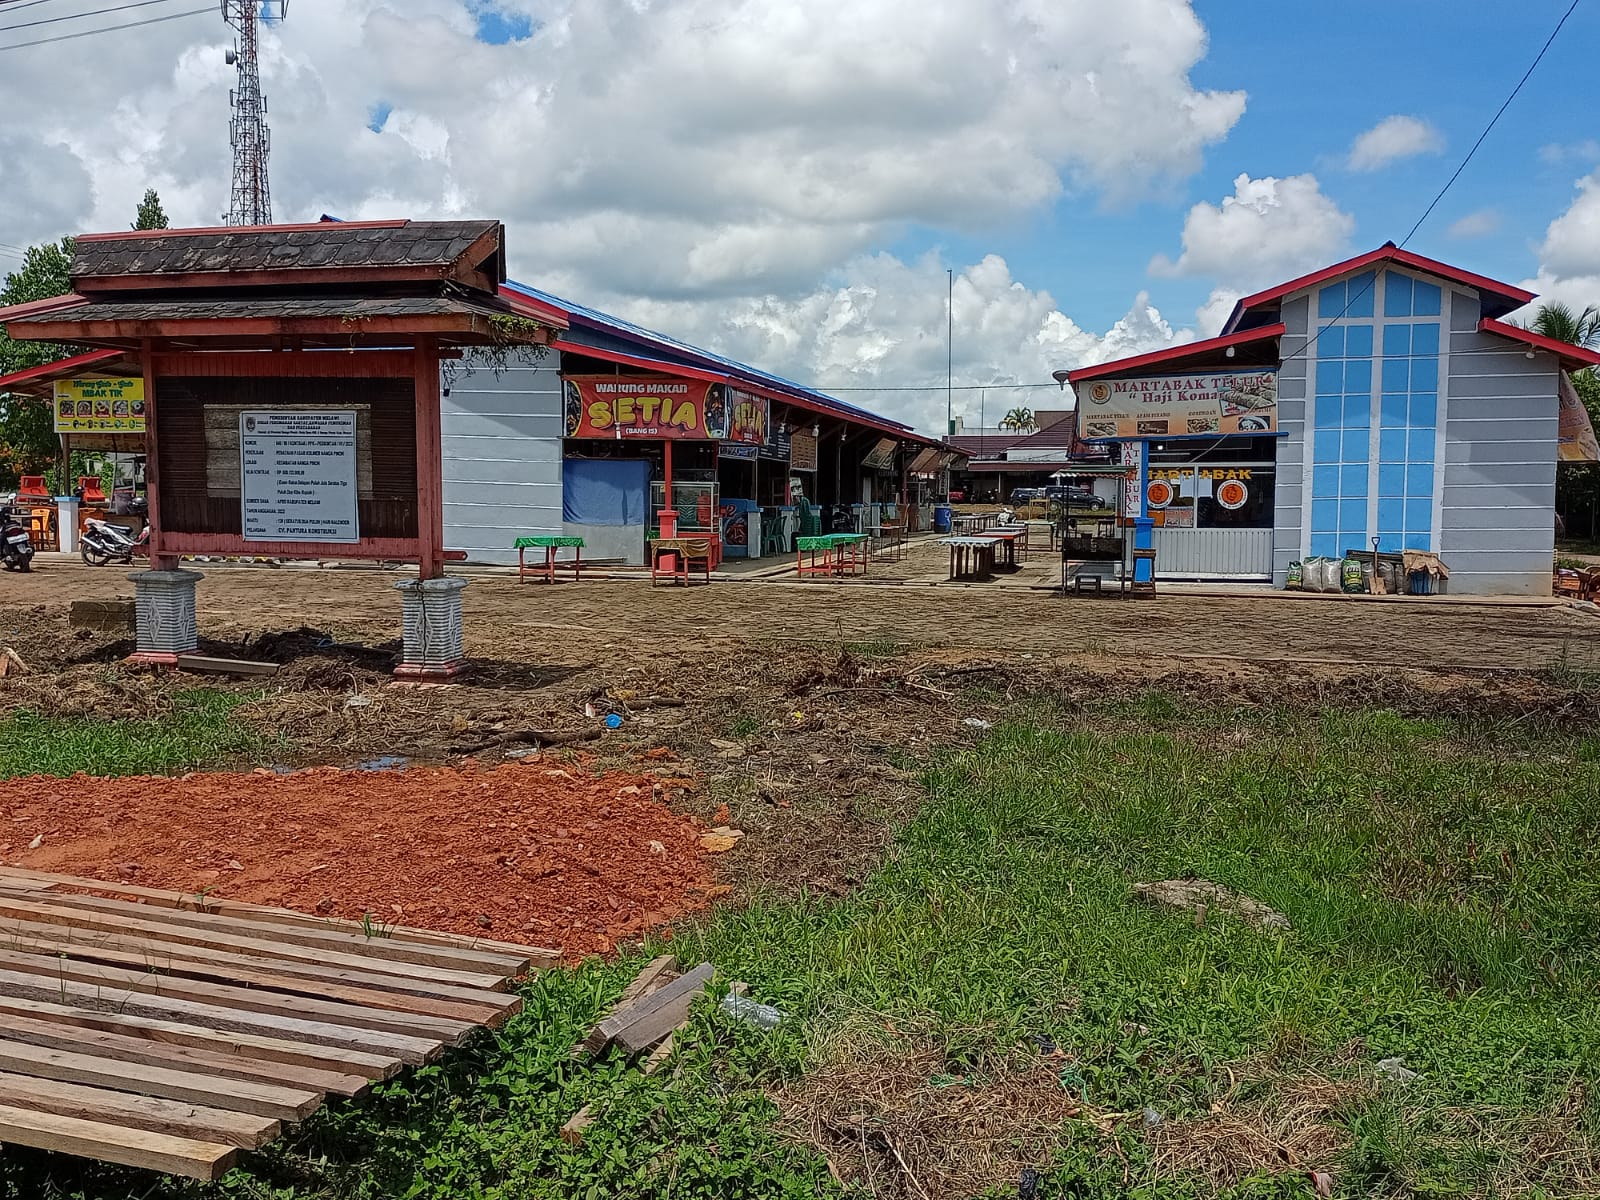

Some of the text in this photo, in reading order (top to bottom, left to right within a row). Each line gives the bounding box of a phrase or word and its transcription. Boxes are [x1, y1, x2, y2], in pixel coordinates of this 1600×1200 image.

[646, 384, 688, 394] MAKAN
[1114, 379, 1205, 393] MARTABAK
[82, 390, 107, 398] MBAK
[1142, 392, 1172, 405] Haji
[588, 397, 698, 431] SETIA
[1123, 442, 1133, 511] MARBAK
